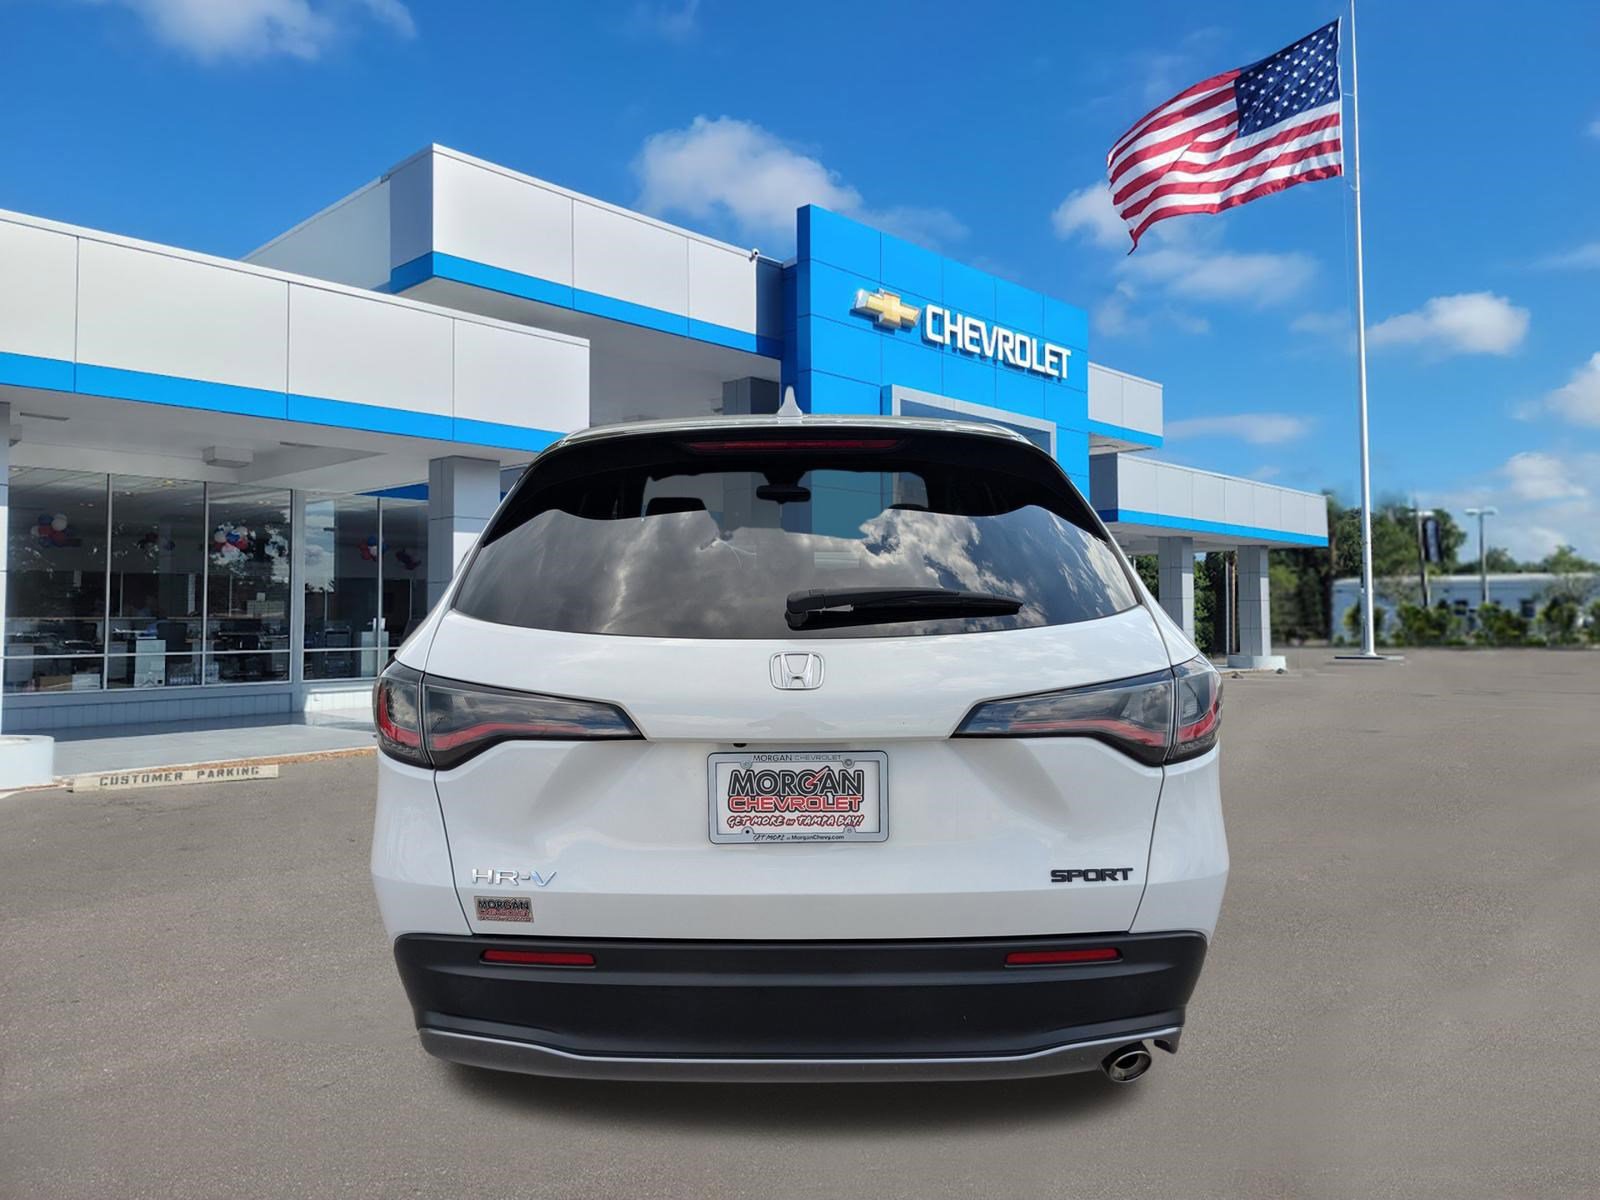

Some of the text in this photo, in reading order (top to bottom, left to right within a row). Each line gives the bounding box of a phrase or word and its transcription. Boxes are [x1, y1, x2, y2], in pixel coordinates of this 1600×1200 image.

[925, 303, 1072, 379] CHEVROLET
[99, 766, 259, 786] CUSTOMER PARKING
[728, 766, 865, 796] MORGAN
[728, 796, 862, 813] CHEVROLET
[727, 815, 750, 828] GET
[751, 815, 785, 827] MORE
[797, 815, 835, 827] TAMPA
[835, 814, 865, 827] BAY!
[472, 868, 557, 887] HR-V
[1050, 867, 1134, 883] SPORT
[478, 898, 529, 910] MORGAN
